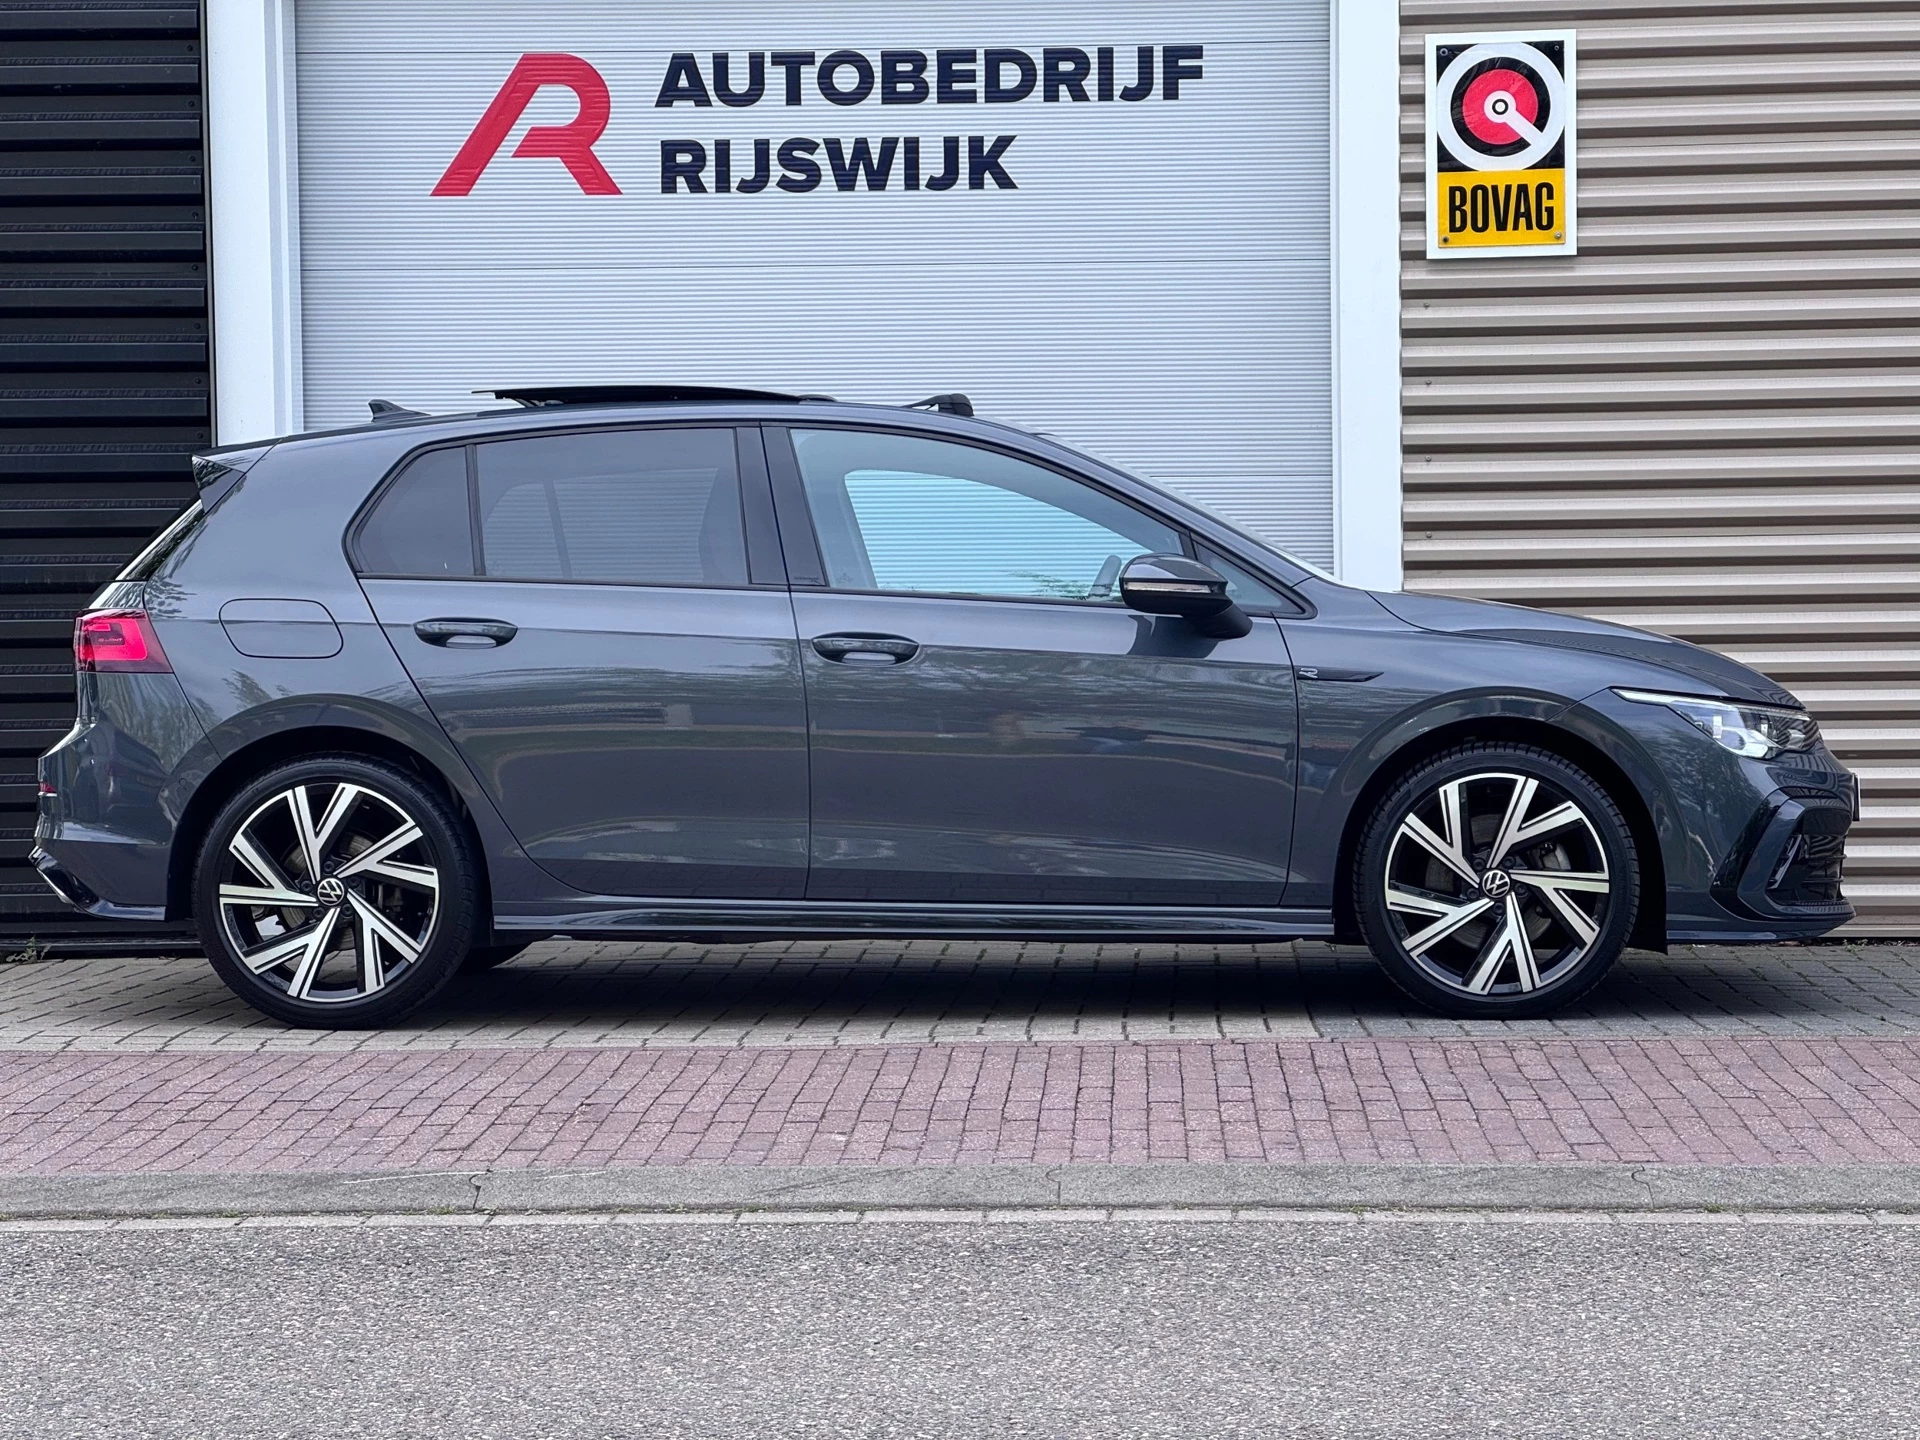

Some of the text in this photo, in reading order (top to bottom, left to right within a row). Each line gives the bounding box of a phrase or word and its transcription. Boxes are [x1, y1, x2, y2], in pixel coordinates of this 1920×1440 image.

[654, 45, 1204, 108] AUTOBEDRIJF
[660, 136, 1019, 194] RIJSWIJK
[1449, 182, 1554, 233] BOVAG
